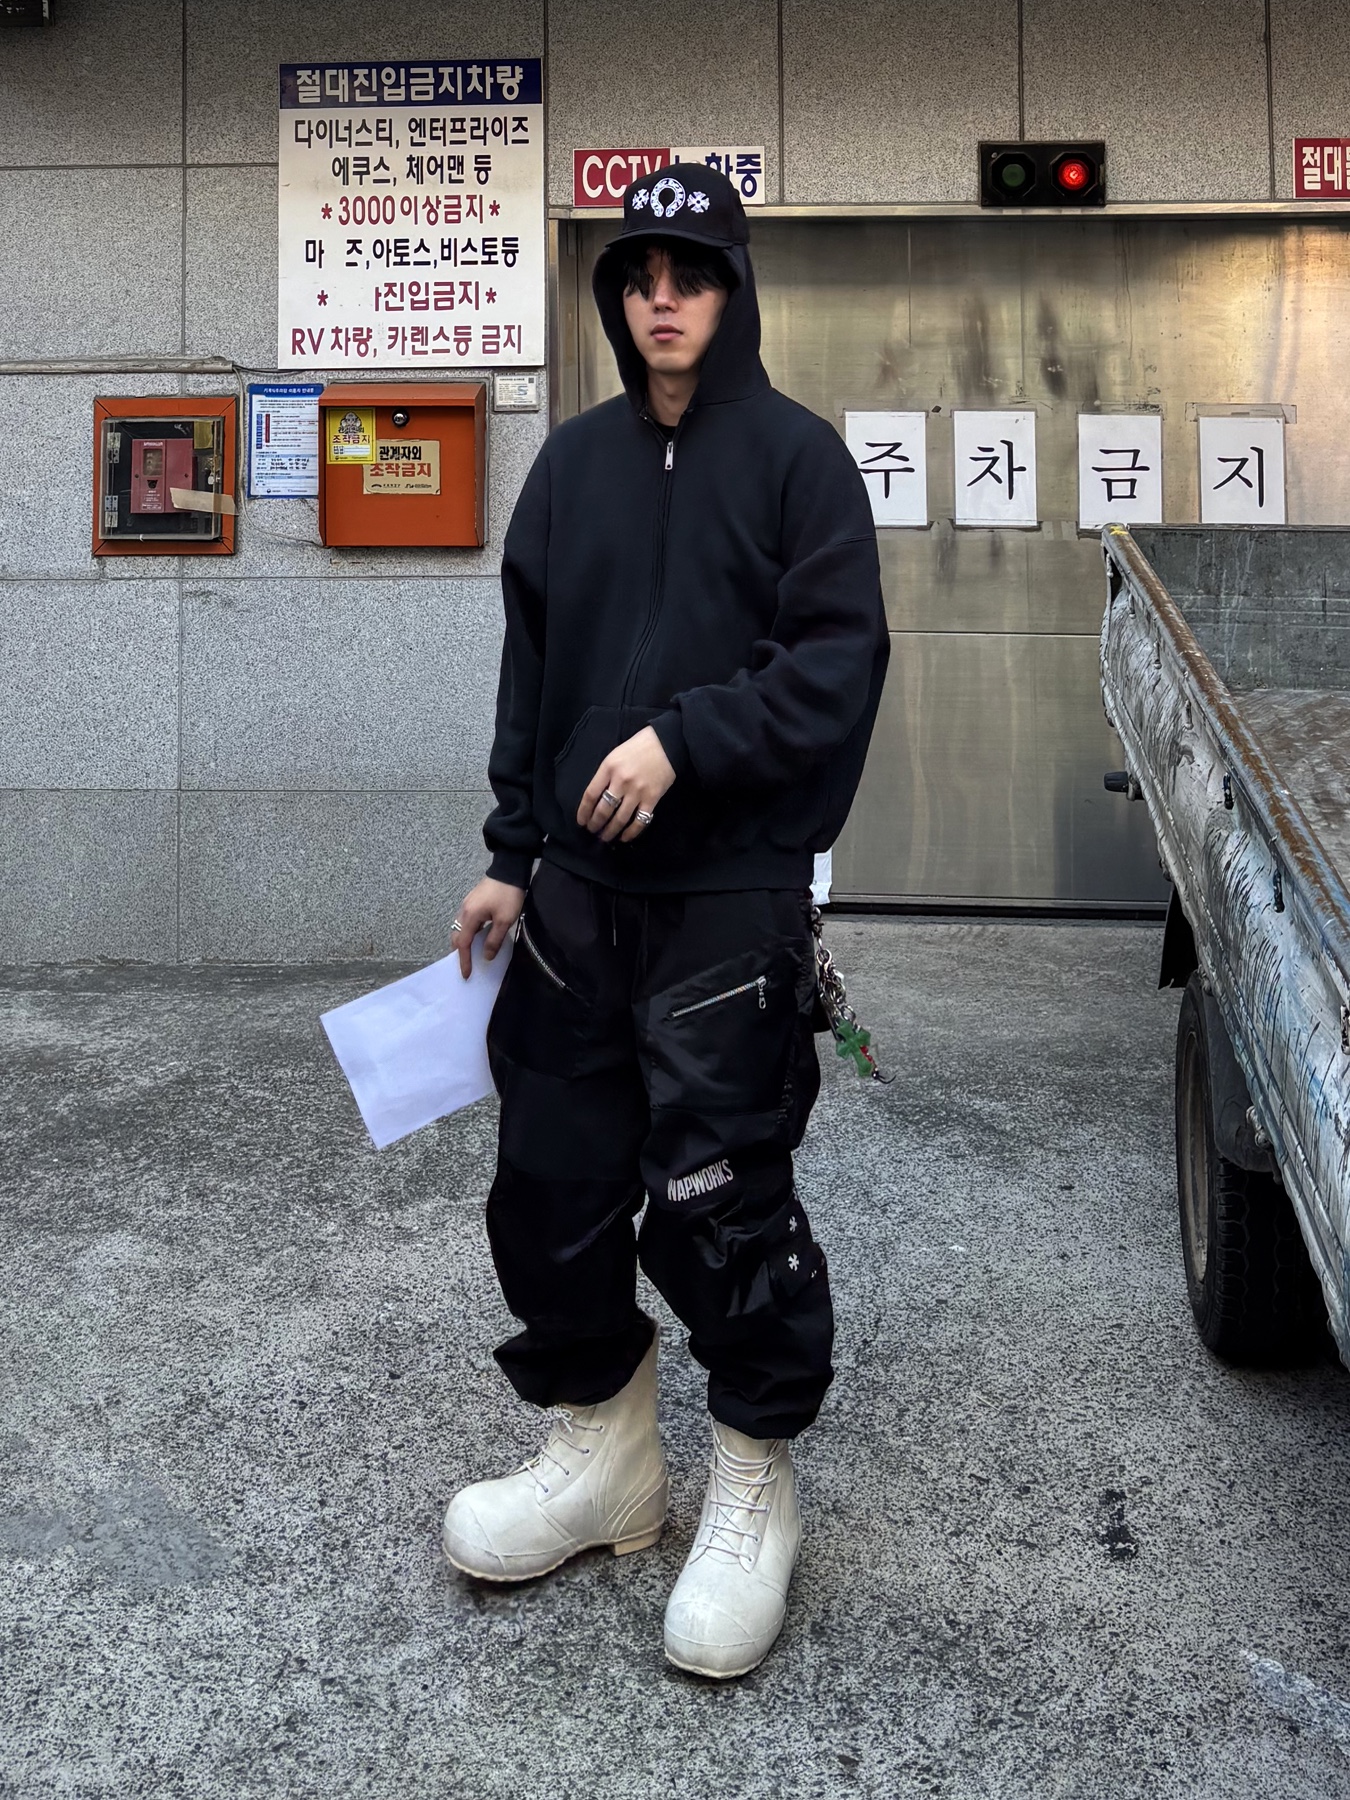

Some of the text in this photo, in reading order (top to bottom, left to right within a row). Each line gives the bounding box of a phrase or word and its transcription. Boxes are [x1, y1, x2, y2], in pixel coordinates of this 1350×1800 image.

[297, 65, 523, 103] 절대진입금지차량
[295, 117, 529, 149] 다이너스티, 엔터프라이즈
[332, 155, 491, 186] 에쿠스, 체어맨 등
[1303, 147, 1350, 190] 절대
[292, 325, 521, 357] RV 차량, 카렌스등 금지
[370, 463, 431, 477] 조작금지
